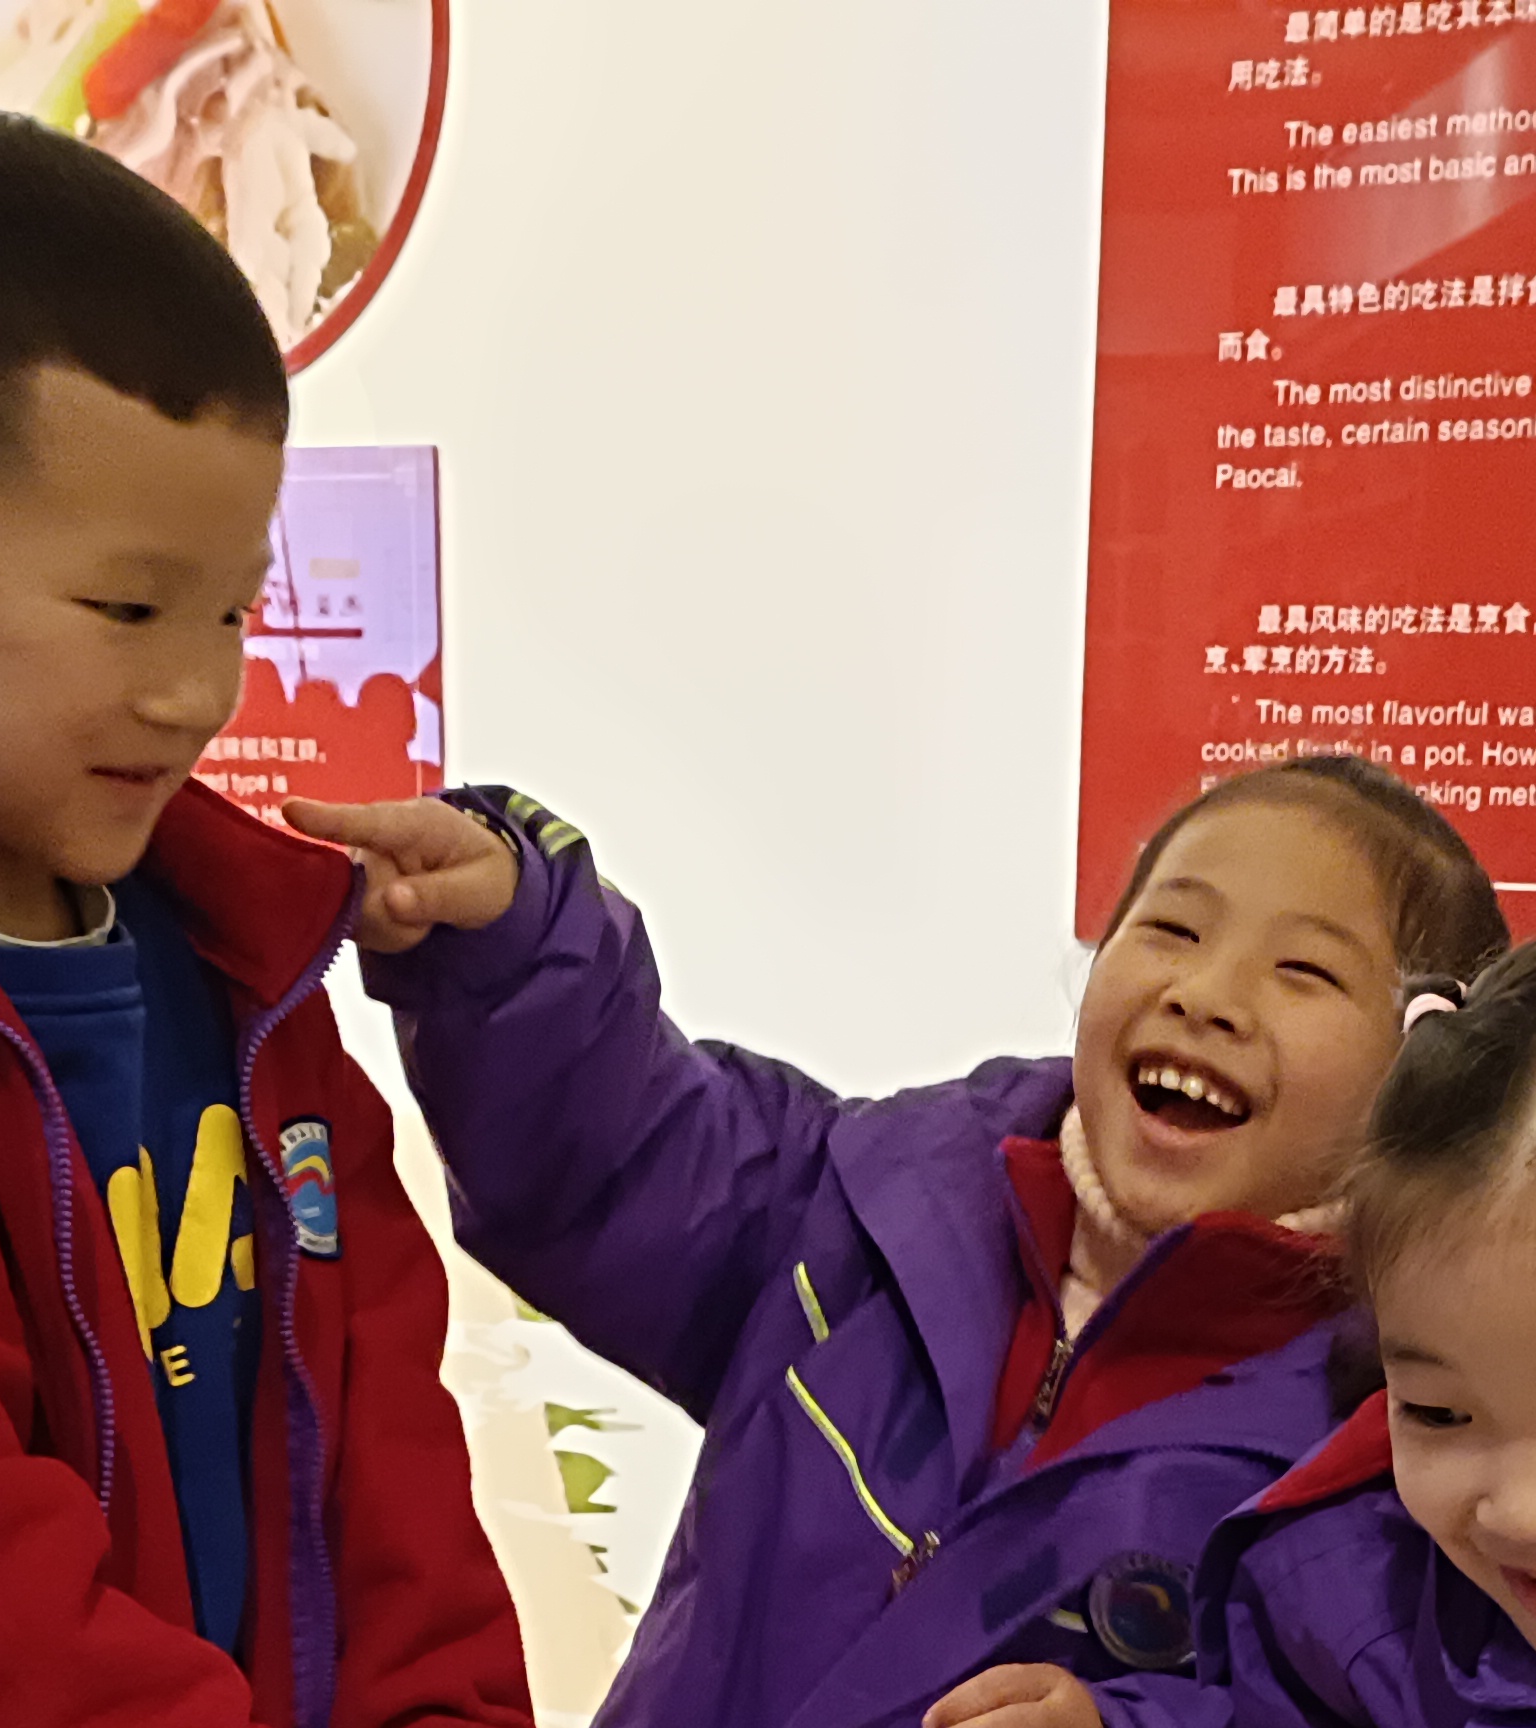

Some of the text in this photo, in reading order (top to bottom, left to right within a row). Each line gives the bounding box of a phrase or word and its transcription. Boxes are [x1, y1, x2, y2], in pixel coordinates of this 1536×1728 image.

[1284, 120, 1334, 150] The
[1342, 113, 1438, 146] easiest
[1227, 167, 1280, 197] This
[1286, 164, 1307, 191] is
[1314, 162, 1352, 190] the
[1360, 157, 1422, 186] most
[1429, 150, 1496, 182] basic
[1273, 379, 1321, 407] The
[1329, 375, 1393, 404] most
[1400, 370, 1532, 402] distinctive
[1217, 424, 1257, 449] the
[1264, 421, 1332, 448] taste,
[1341, 416, 1430, 447] certain
[1216, 460, 1303, 490] Paocai.
[1255, 698, 1302, 725] The
[1311, 701, 1374, 728] most
[1383, 700, 1489, 726] flavorful
[1201, 738, 1290, 763] cooked
[1370, 740, 1393, 762] in
[1401, 745, 1416, 766] a
[1424, 742, 1473, 771] pot.
